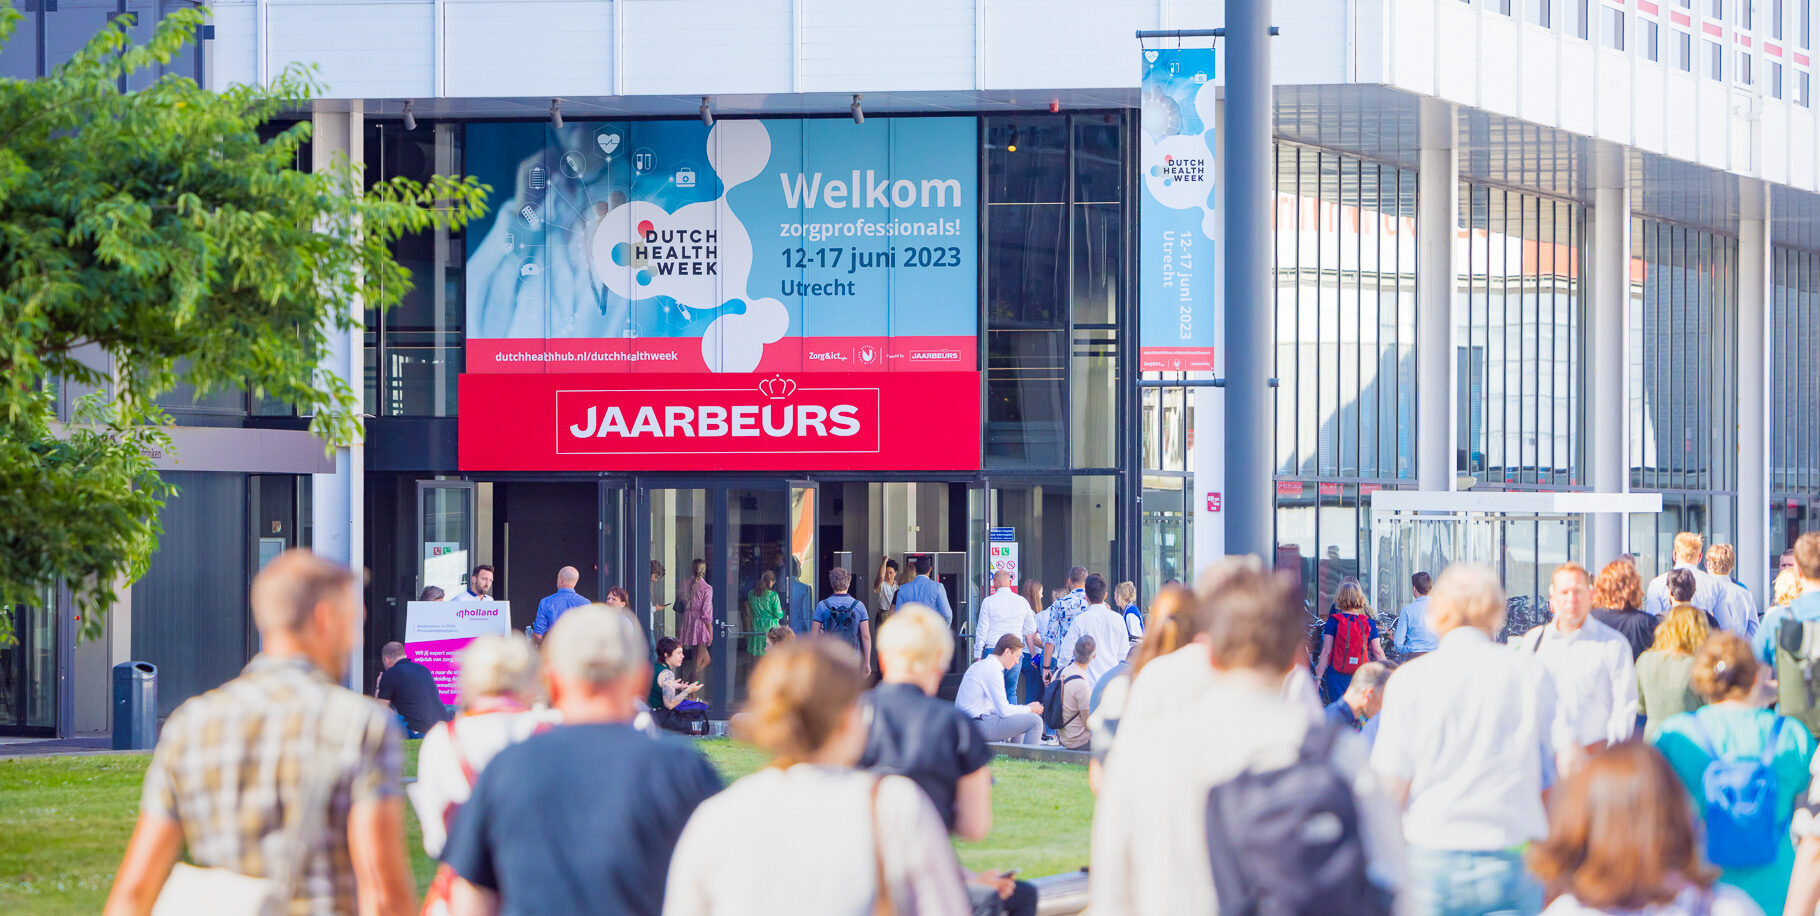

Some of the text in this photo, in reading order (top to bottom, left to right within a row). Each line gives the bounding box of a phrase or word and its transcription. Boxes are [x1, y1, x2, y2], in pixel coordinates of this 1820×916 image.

[1168, 159, 1205, 167] DUTCH
[1173, 174, 1204, 182] WEEK
[780, 170, 962, 208] Welkom
[646, 229, 717, 243] DUTCH
[780, 218, 961, 242] zorgprofessionals!
[636, 246, 717, 259] HEALTH
[781, 247, 961, 274] 12-17 juni 2023
[1163, 231, 1175, 288] Utrecht
[657, 262, 717, 275] WEEK
[781, 279, 856, 296] Utrecht
[1177, 231, 1192, 340] 12-17 juni 2023
[569, 404, 861, 438] JAARBEURS
[456, 608, 498, 618] inholland
